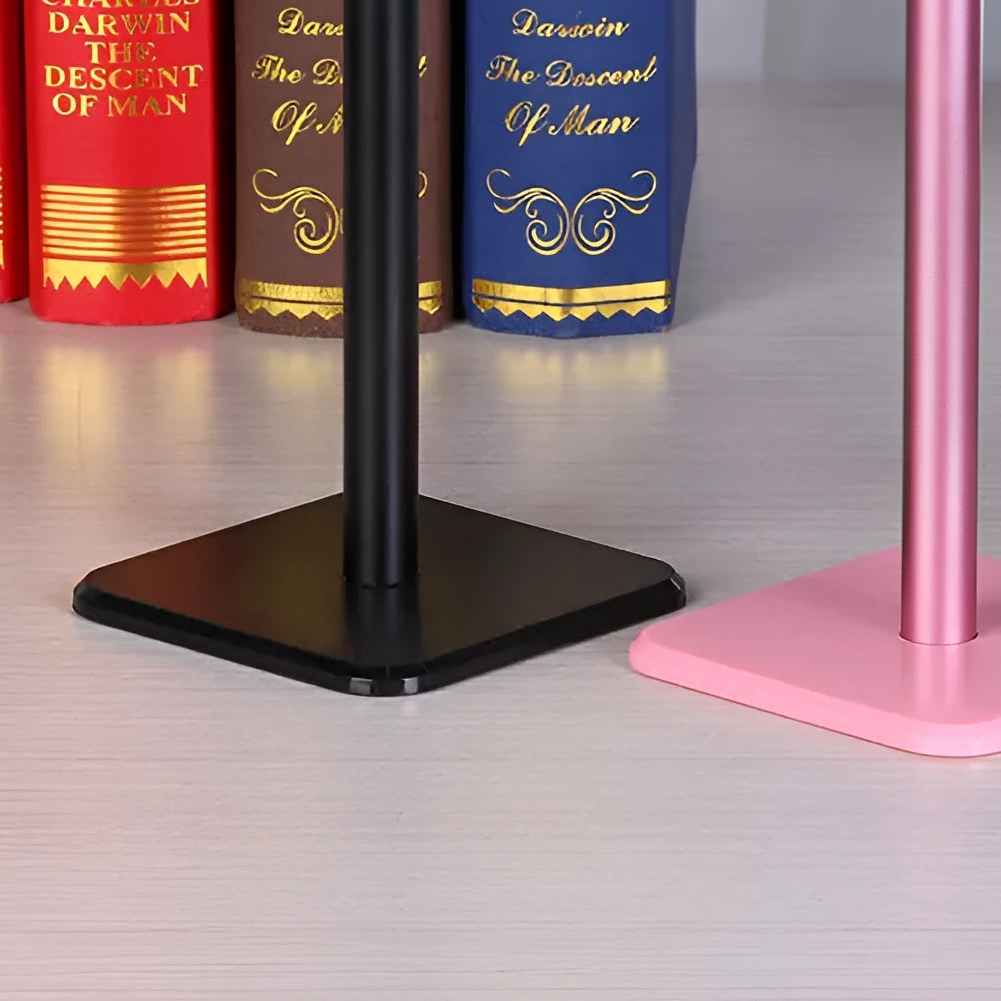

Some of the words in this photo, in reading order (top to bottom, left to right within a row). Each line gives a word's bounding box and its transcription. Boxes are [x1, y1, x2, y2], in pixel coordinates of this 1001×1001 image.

[48, 11, 190, 36] DARWIN
[84, 41, 157, 64] THE
[44, 64, 204, 91] DESCENT
[251, 54, 305, 84] The
[485, 54, 540, 85] The
[52, 93, 99, 117] OF
[107, 93, 188, 118] MAN
[271, 99, 318, 146] Of
[504, 101, 549, 147] Of
[548, 103, 640, 136] Man
